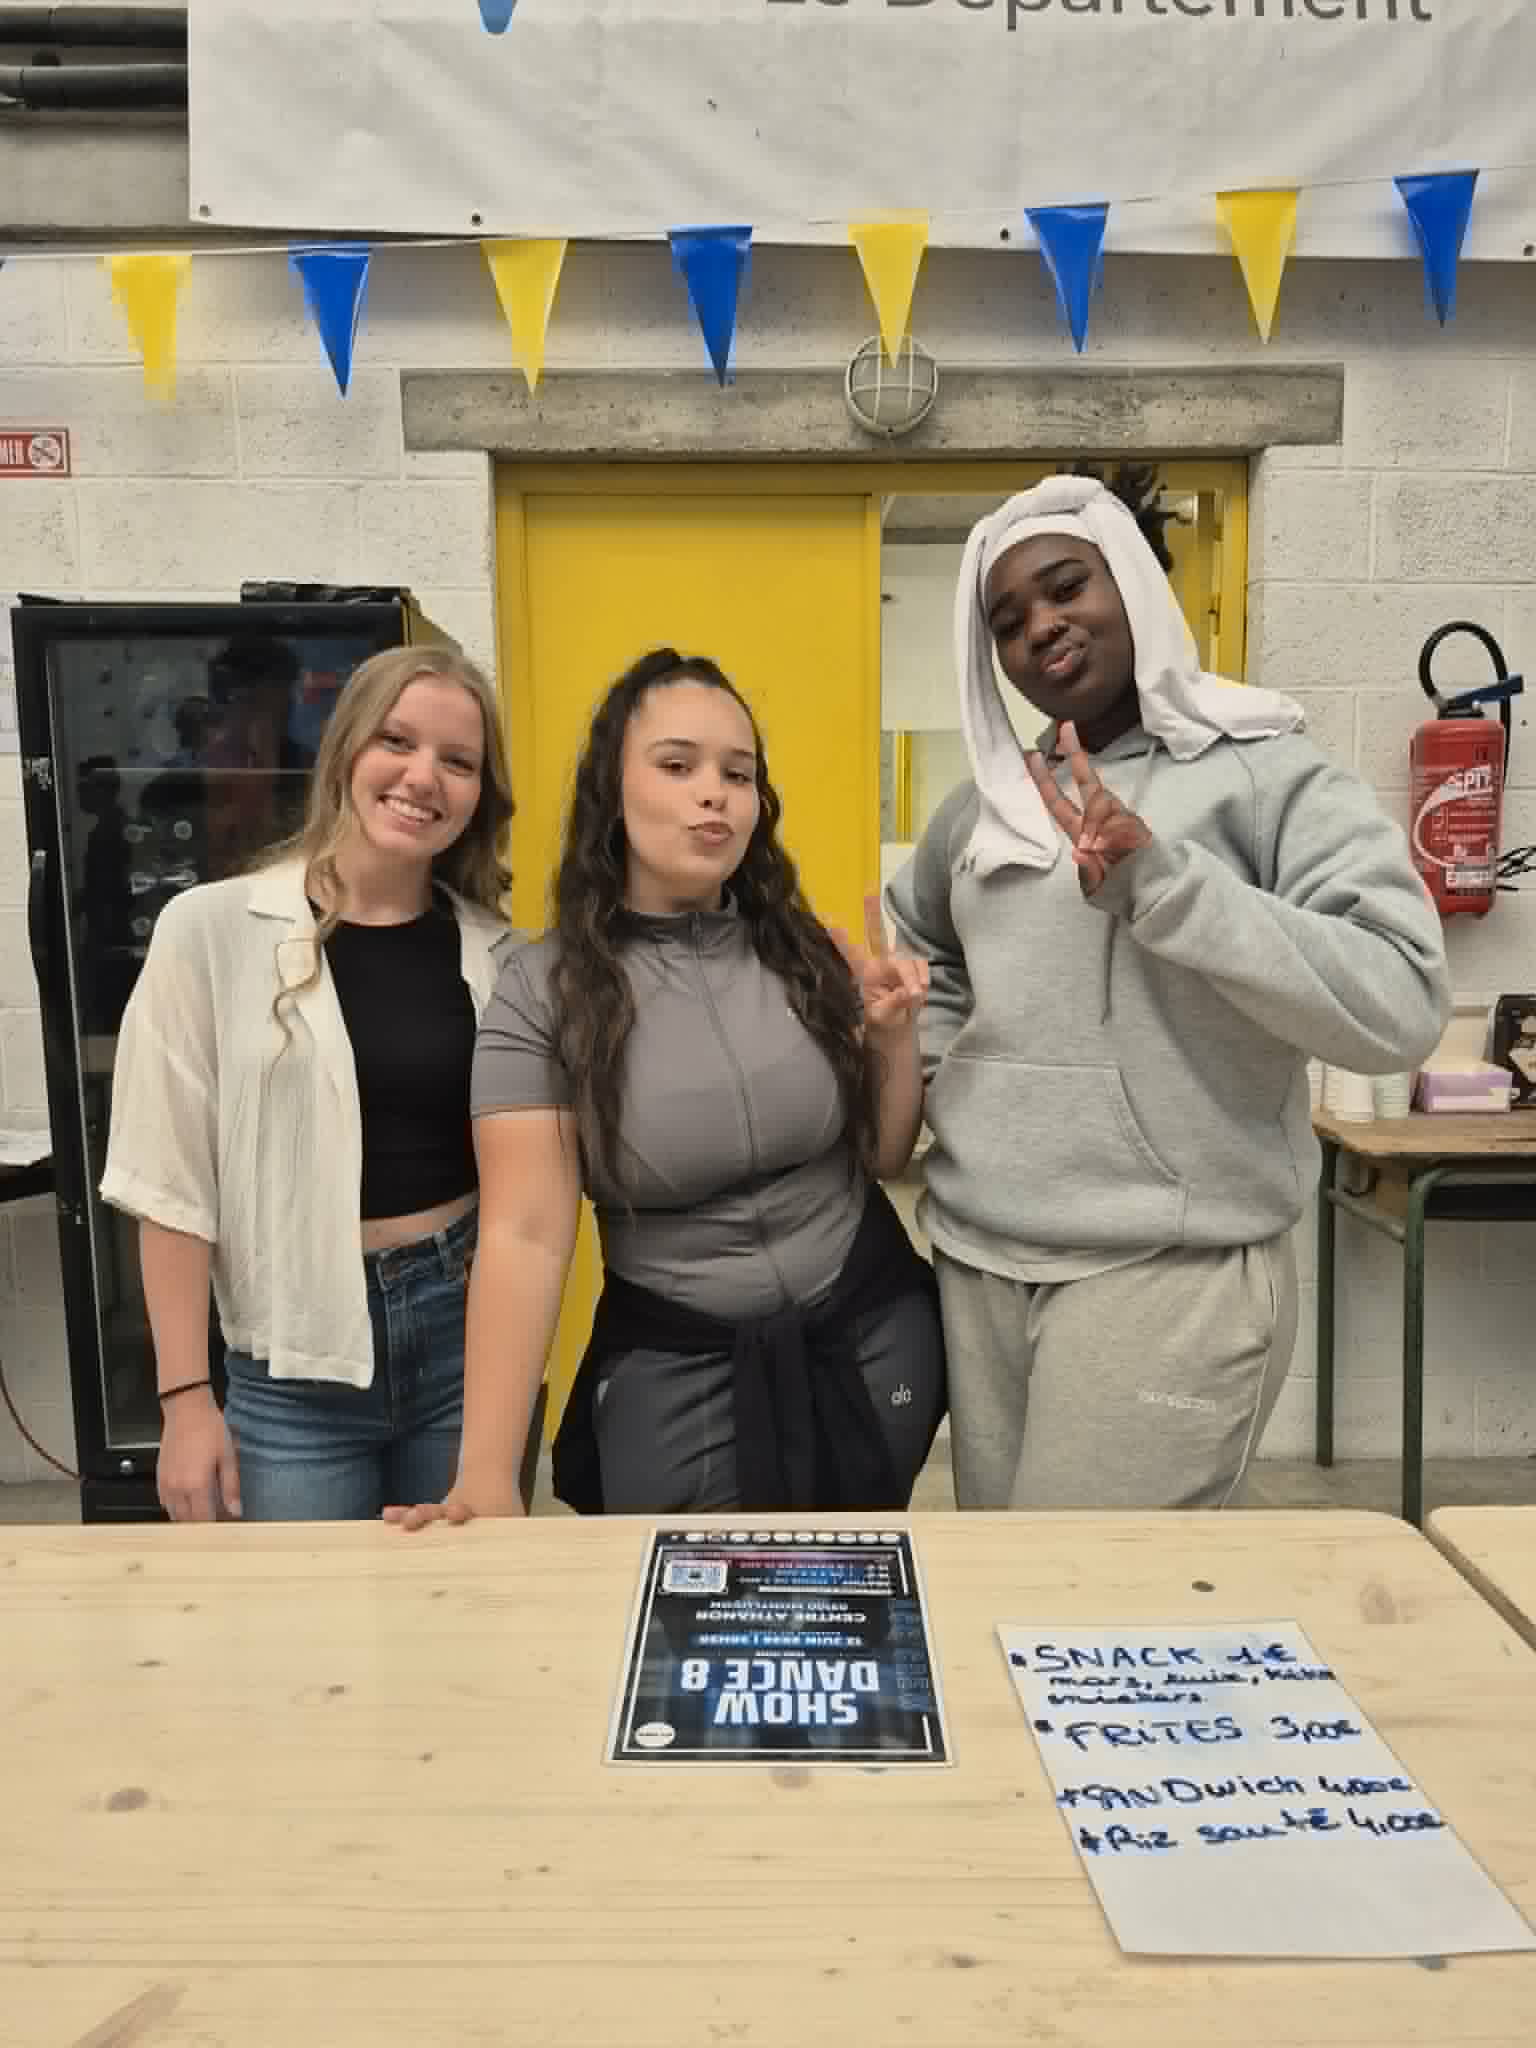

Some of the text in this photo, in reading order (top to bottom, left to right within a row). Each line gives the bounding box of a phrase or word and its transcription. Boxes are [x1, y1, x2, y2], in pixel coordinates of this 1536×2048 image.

[792, 1612, 867, 1623] CENTRE
[1034, 1644, 1204, 1673] SNACK
[680, 1658, 880, 1692] DANCE 8
[712, 1692, 859, 1726] SHOW
